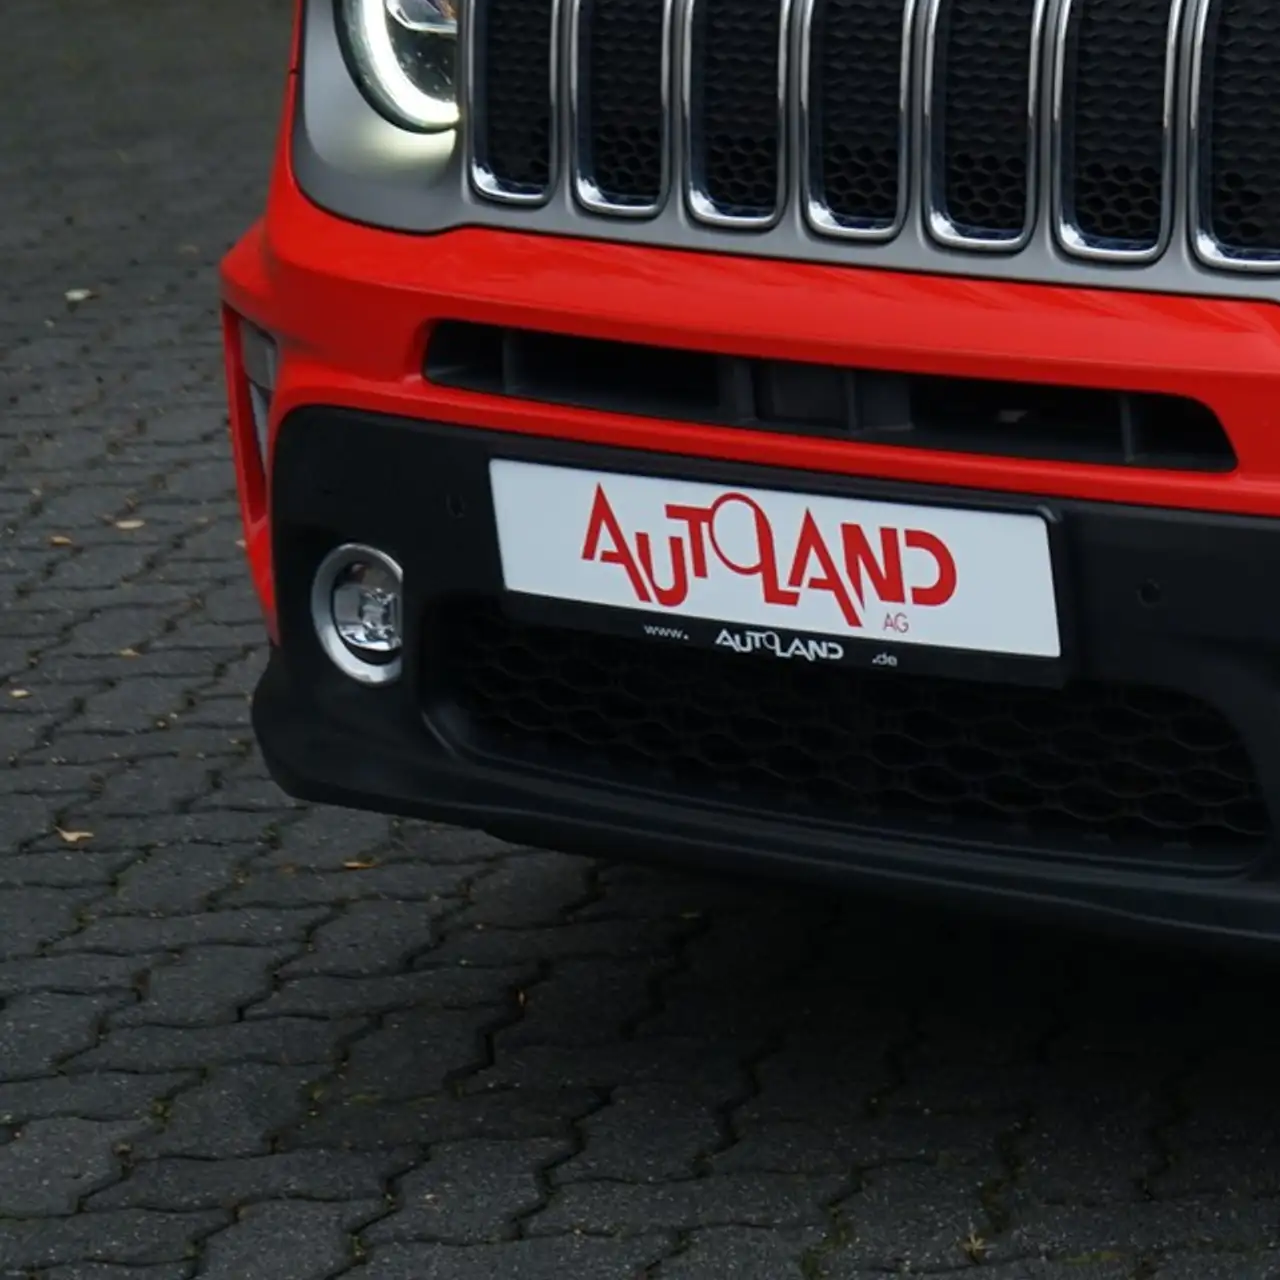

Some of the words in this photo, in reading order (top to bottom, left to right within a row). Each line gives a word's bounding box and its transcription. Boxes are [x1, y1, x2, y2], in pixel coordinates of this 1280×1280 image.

[581, 482, 957, 628] AUTOLAND
[883, 612, 909, 634] AG
[644, 624, 689, 640] www.
[715, 628, 844, 661] AUTOLAND
[872, 651, 898, 667] .de
